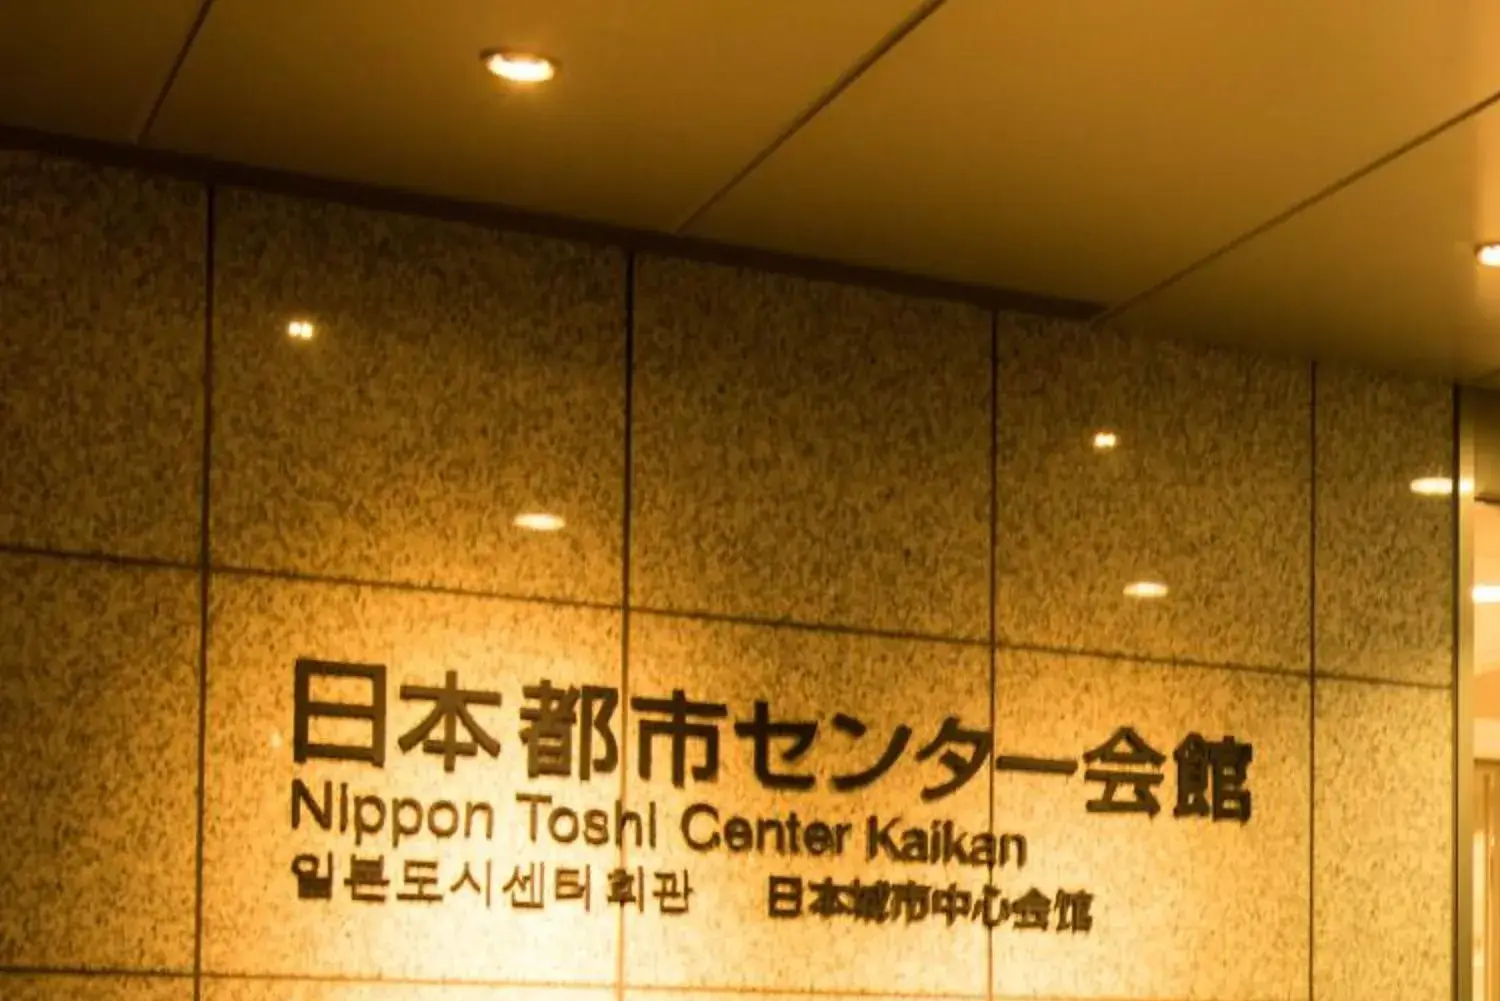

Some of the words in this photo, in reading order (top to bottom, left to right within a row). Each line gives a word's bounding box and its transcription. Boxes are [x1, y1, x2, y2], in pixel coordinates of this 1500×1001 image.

[293, 657, 1253, 825] 日本都市センター会館
[291, 778, 494, 849] Nippon
[516, 792, 656, 849] Toshi
[681, 803, 852, 856] Center
[866, 813, 1027, 868] Kaikan
